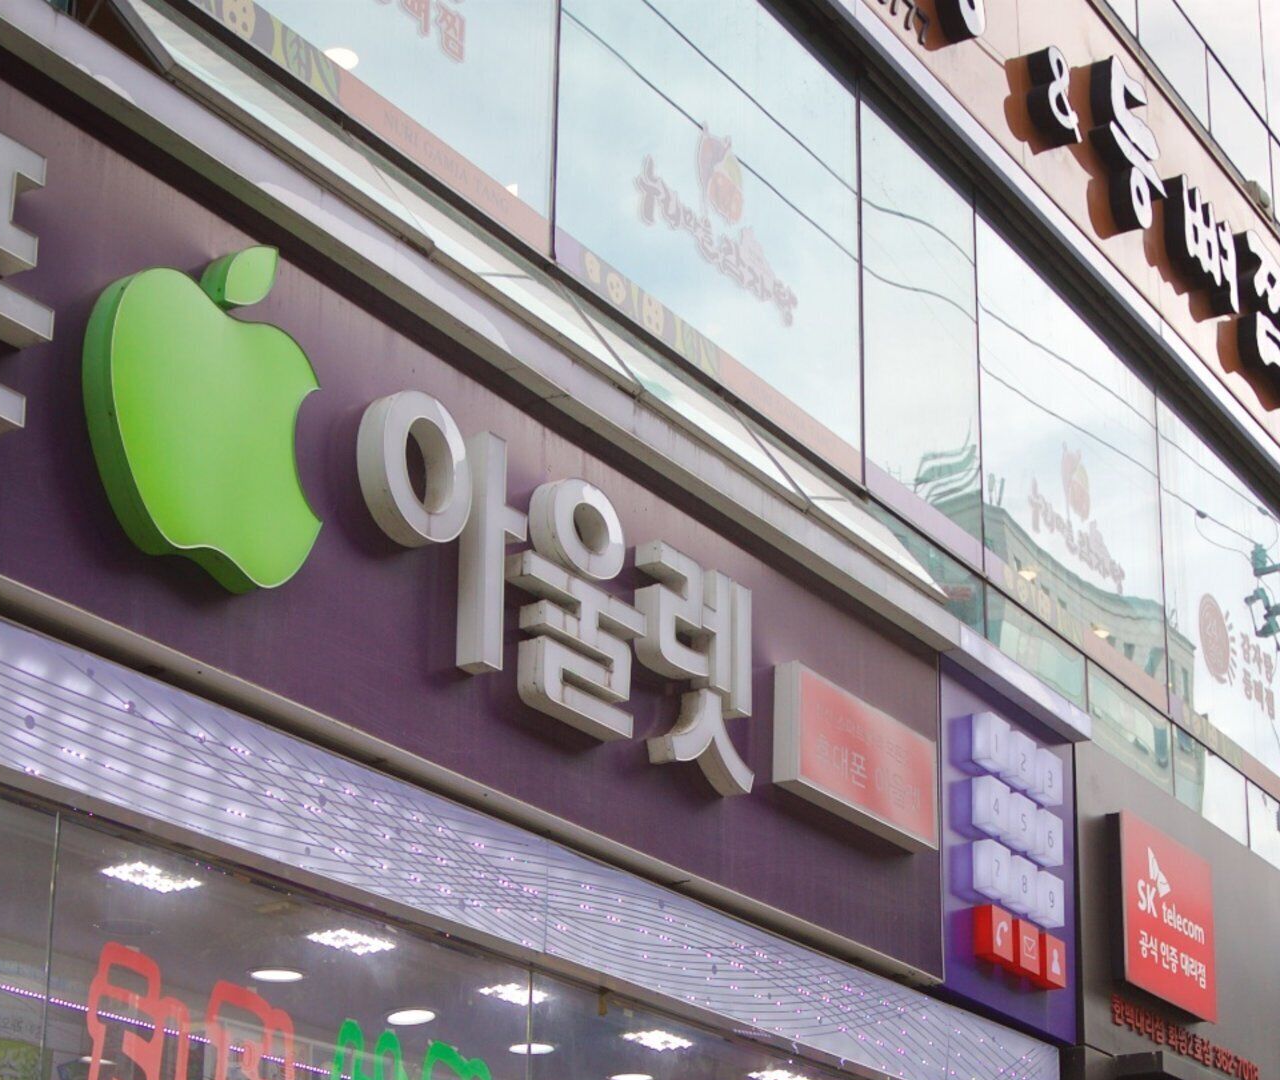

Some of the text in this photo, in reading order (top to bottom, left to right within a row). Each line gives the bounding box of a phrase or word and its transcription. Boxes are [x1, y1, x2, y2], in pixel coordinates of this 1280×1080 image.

[357, 390, 755, 798] 아울렛
[1136, 878, 1206, 945] SK telecom
[1138, 929, 1208, 990] 공식 인증 대리점
